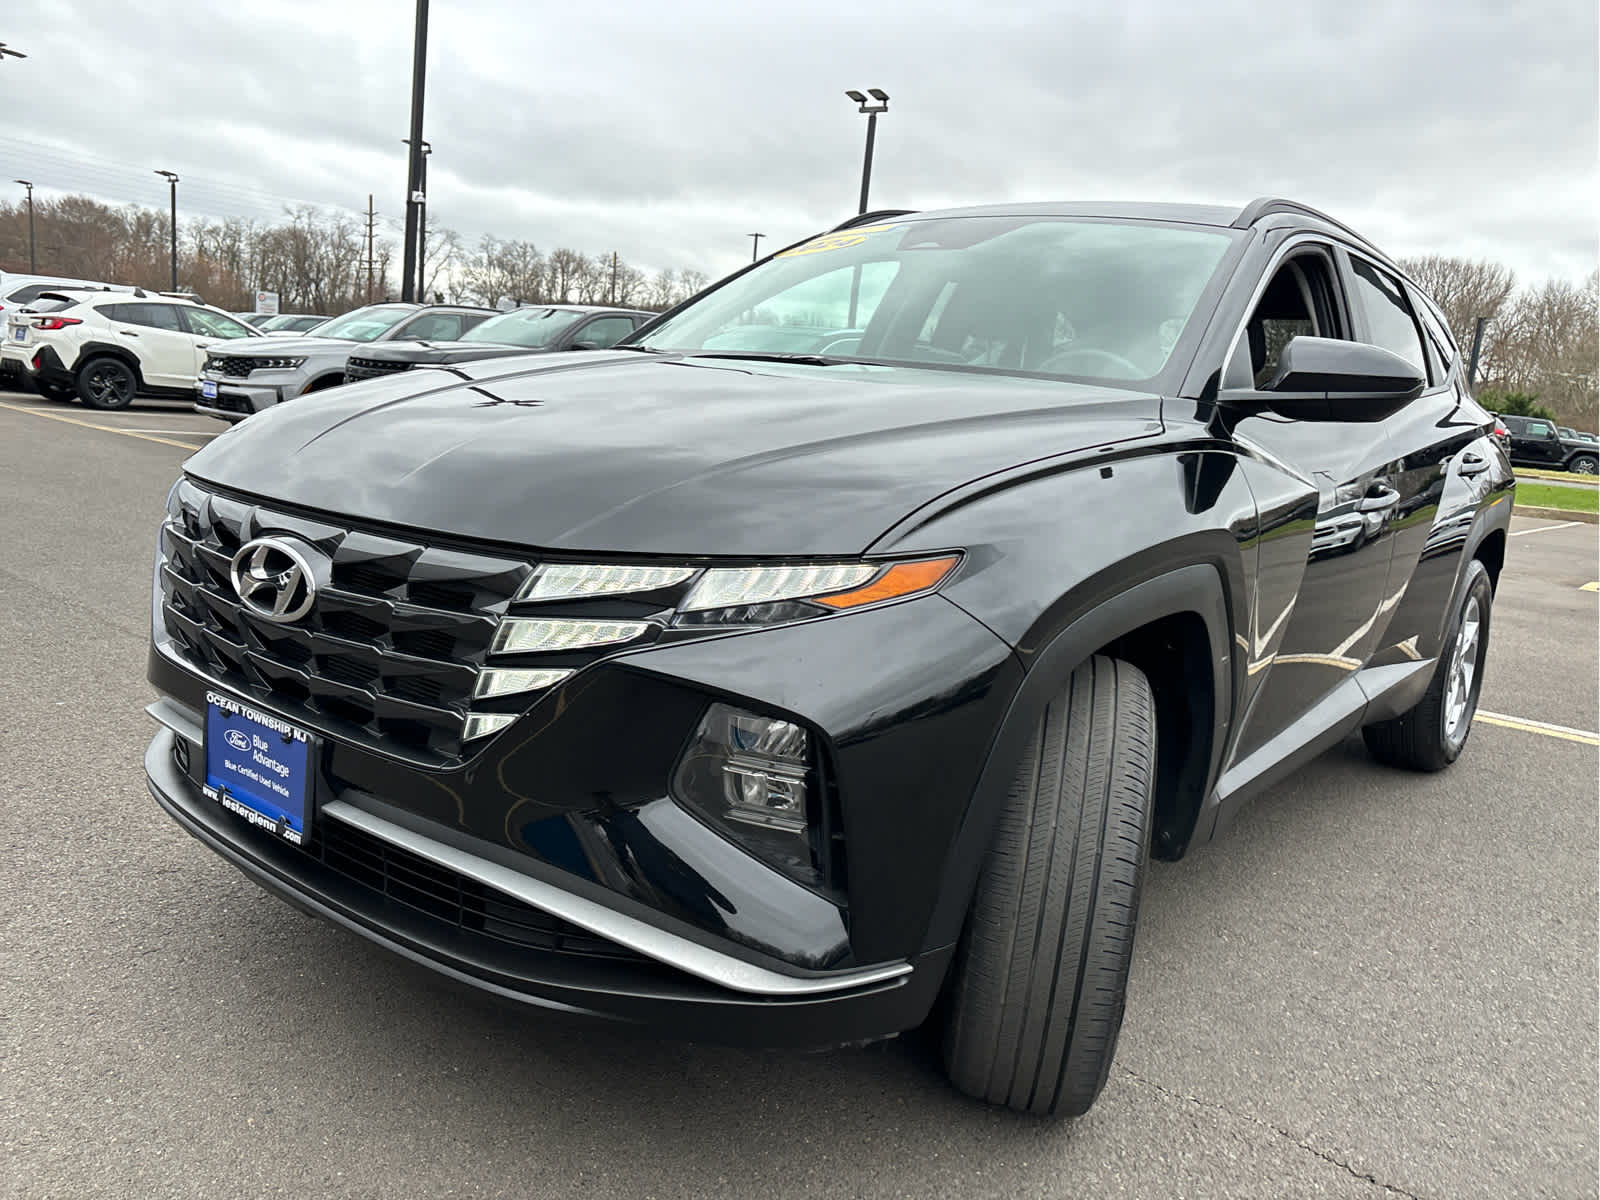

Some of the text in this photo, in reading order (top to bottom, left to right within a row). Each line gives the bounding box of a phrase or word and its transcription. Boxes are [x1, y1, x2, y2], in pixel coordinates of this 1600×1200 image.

[206, 692, 239, 714] OCEAN
[293, 730, 307, 743] NJ
[229, 732, 247, 749] Ford
[252, 734, 268, 752] Blue
[253, 750, 290, 778] Advantage
[224, 759, 290, 798] Blue Certified Used Vehicle
